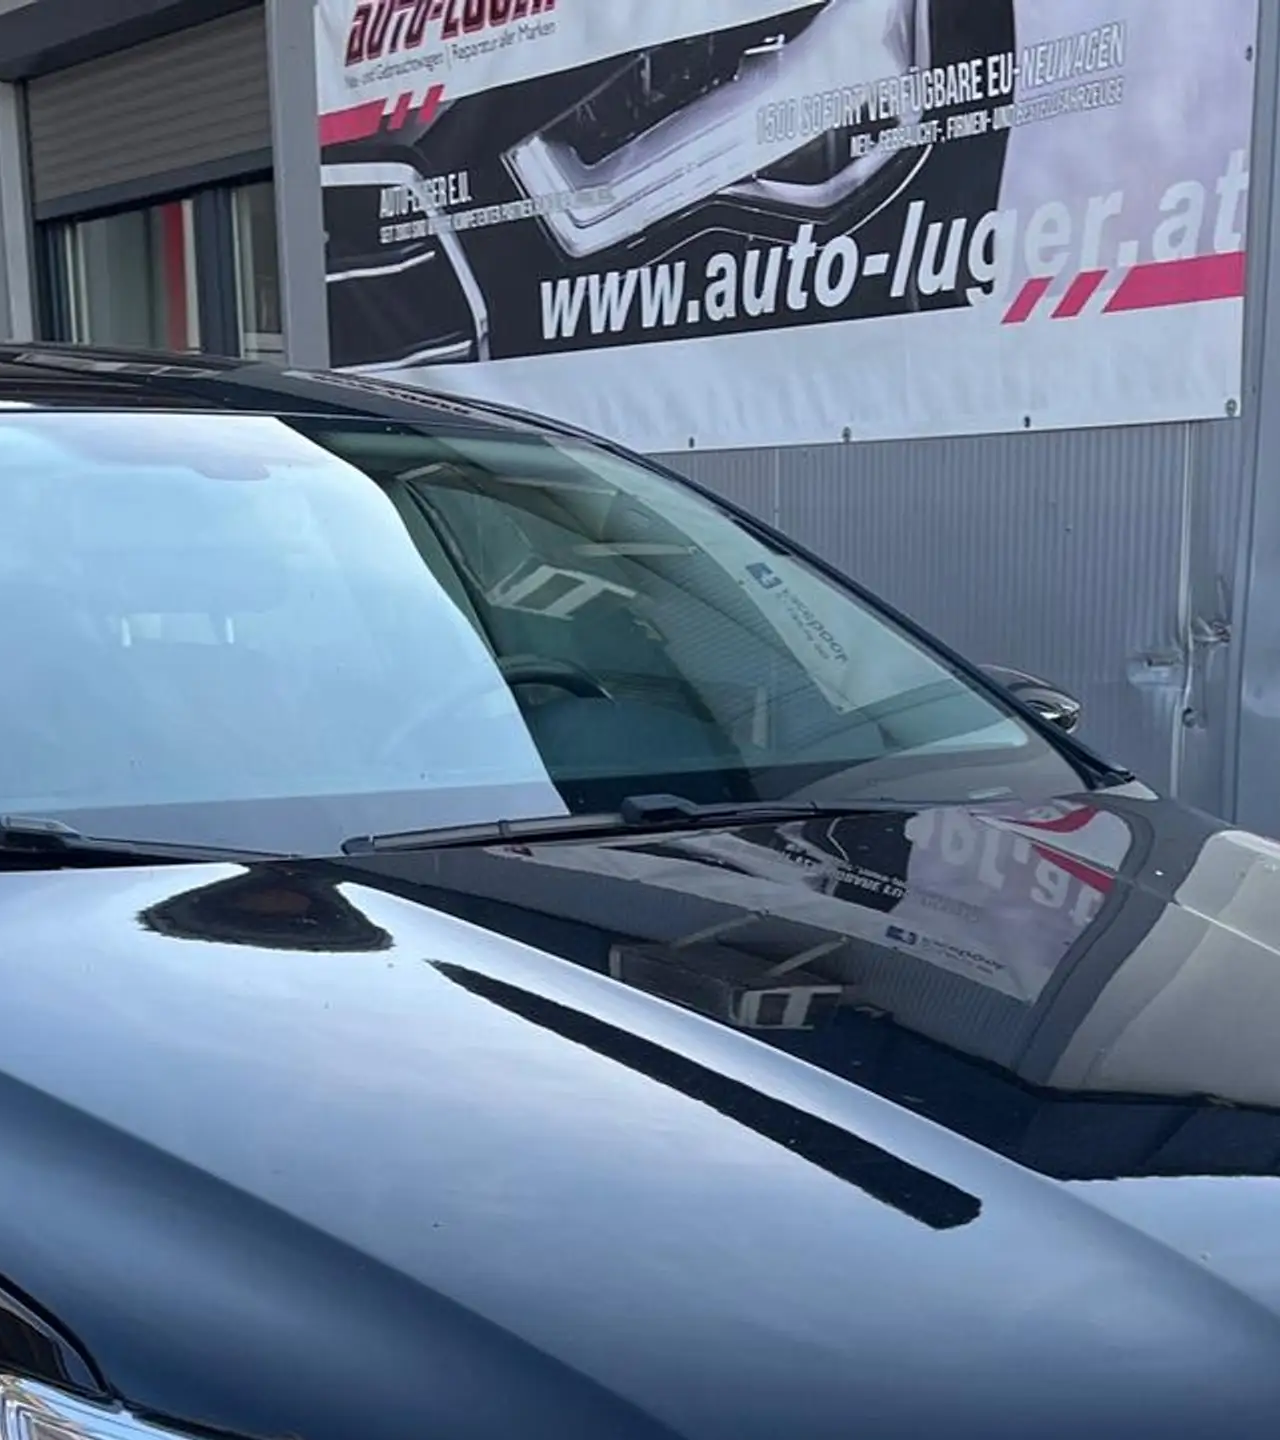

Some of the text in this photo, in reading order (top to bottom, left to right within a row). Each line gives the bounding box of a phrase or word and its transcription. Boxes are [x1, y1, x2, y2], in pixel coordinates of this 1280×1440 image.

[867, 58, 983, 121] VERFÜGBARE
[986, 21, 1126, 98] EU-NEUWAGEN
[540, 149, 1250, 338] www.auto-luger.at
